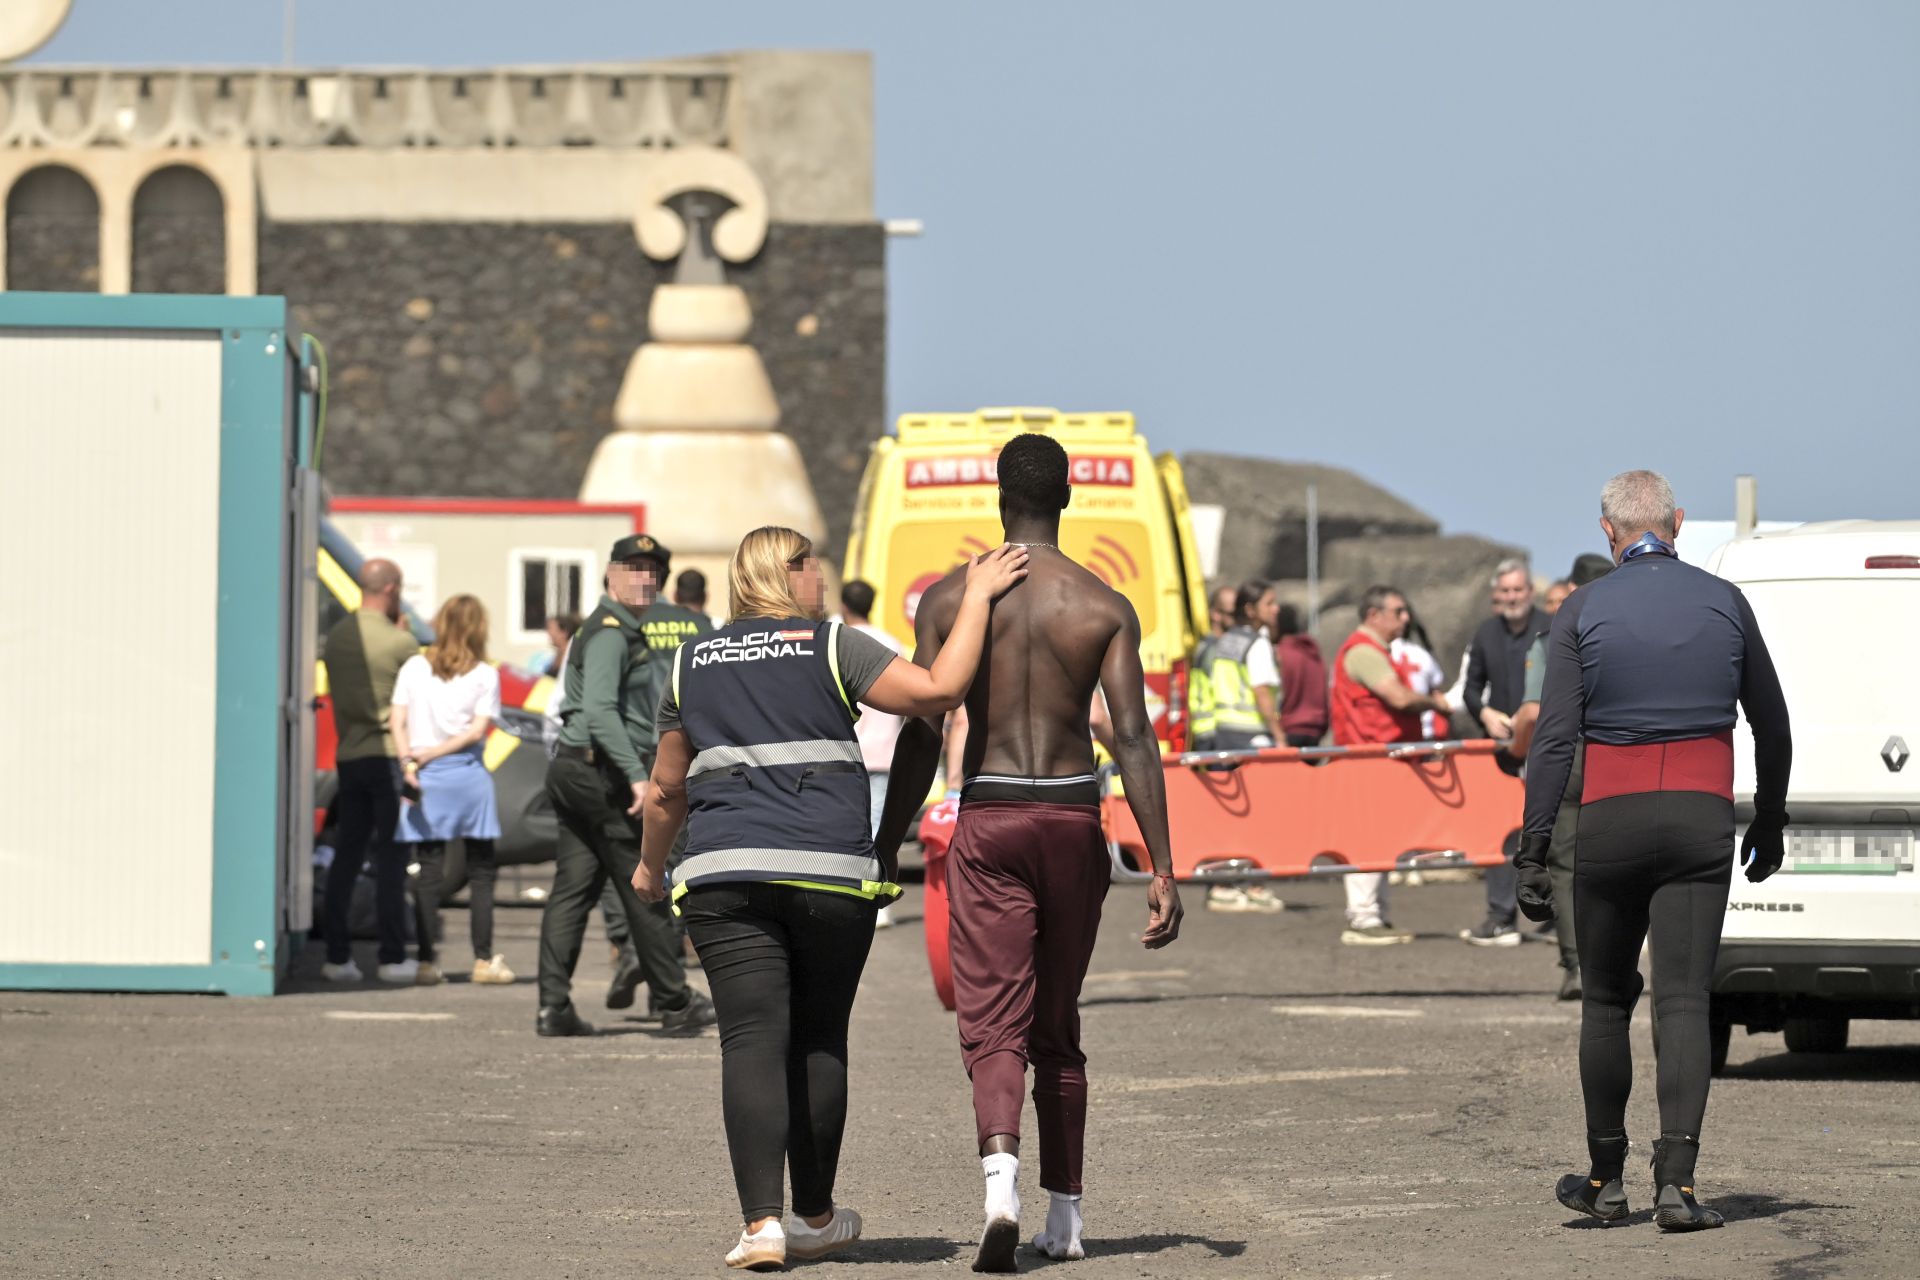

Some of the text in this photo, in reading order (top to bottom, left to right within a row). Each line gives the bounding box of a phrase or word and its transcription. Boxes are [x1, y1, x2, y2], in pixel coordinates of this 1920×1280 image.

[908, 457, 1130, 485] AMBUCIA
[641, 621, 699, 635] ARDIA
[646, 635, 683, 651] IVIL
[694, 631, 784, 655] POLICIA
[692, 642, 814, 669] NACIONAL
[1728, 902, 1804, 912] XPRESS
